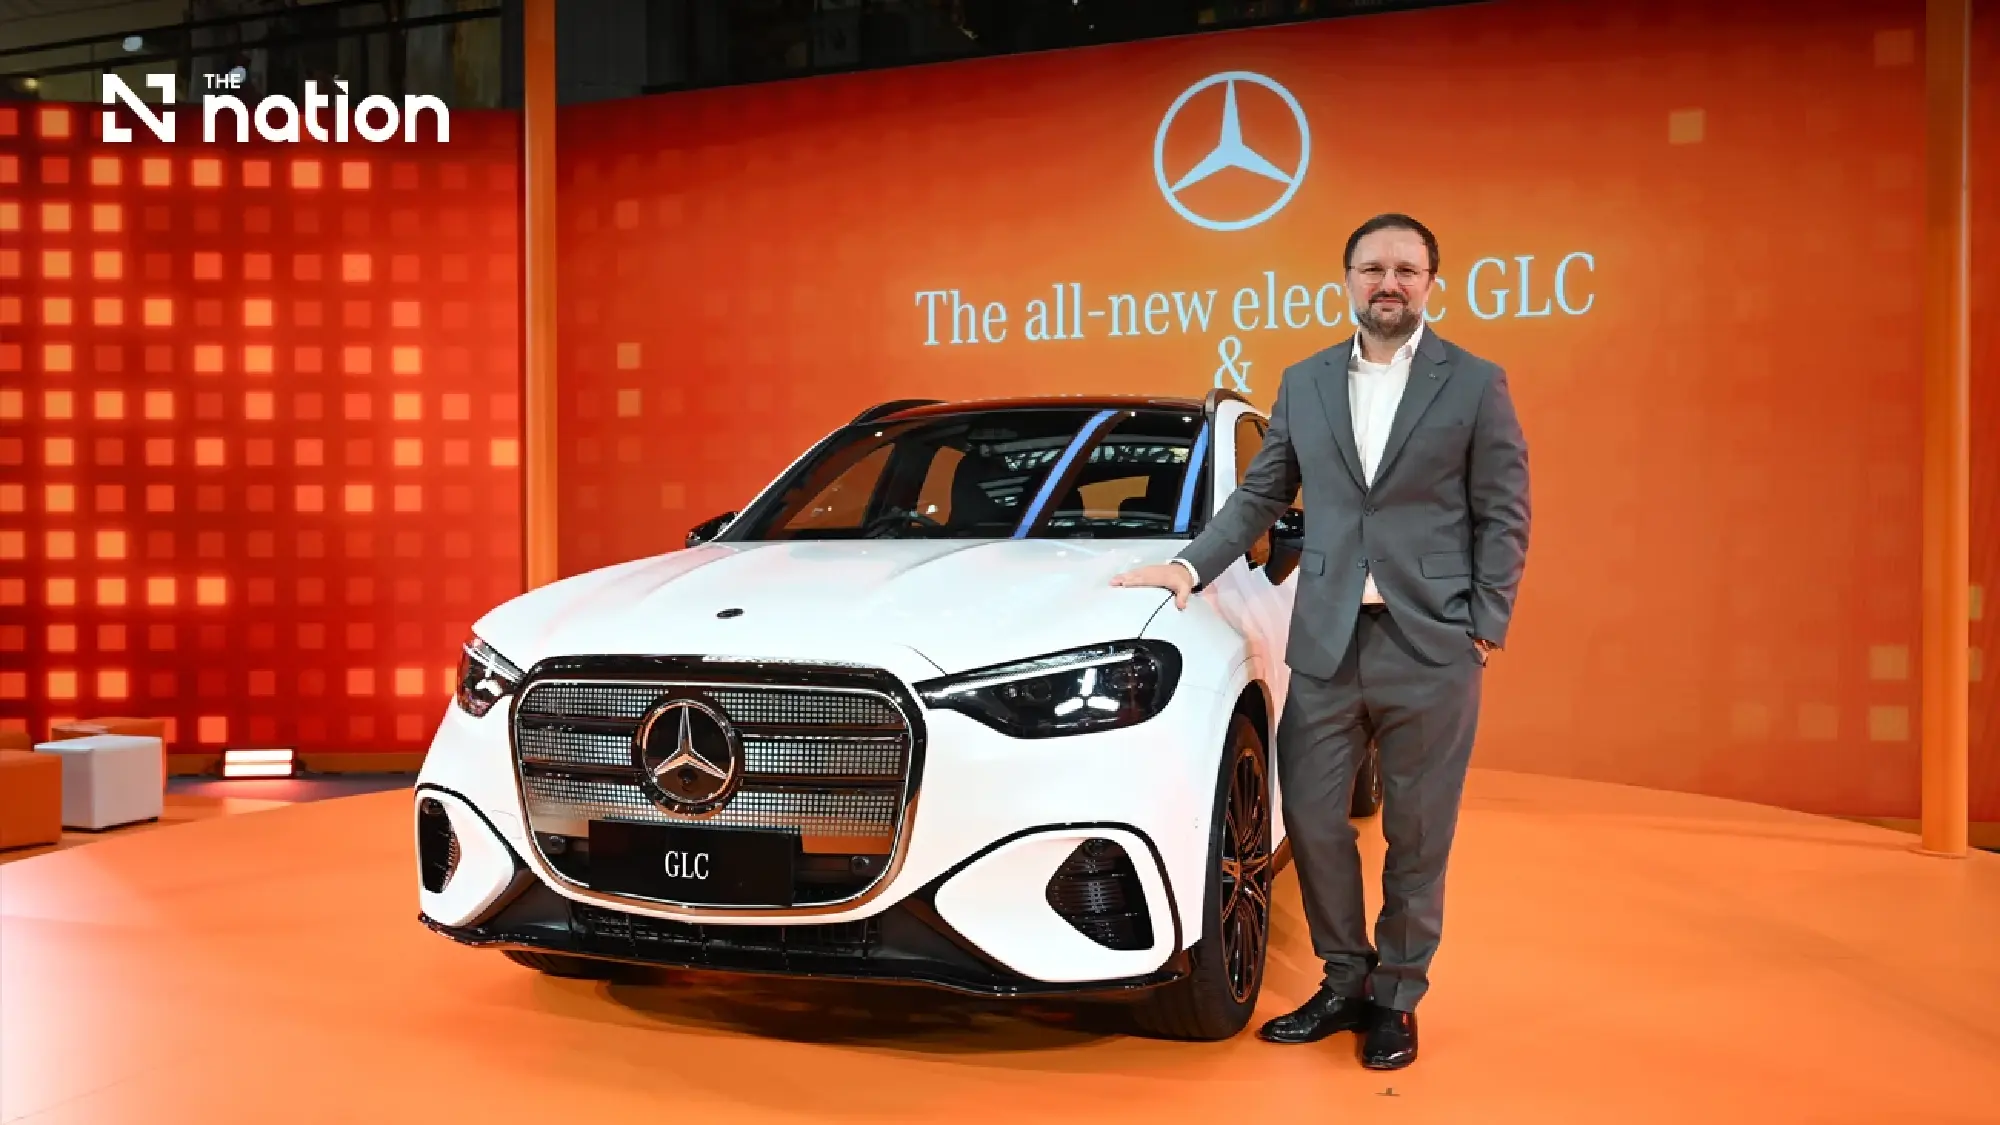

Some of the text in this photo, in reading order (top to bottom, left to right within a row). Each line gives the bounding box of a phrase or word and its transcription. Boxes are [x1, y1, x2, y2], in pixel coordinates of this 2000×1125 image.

[915, 252, 1596, 346] The all-new elecc GLC
[1213, 335, 1253, 393] &
[664, 850, 709, 880] GLC
